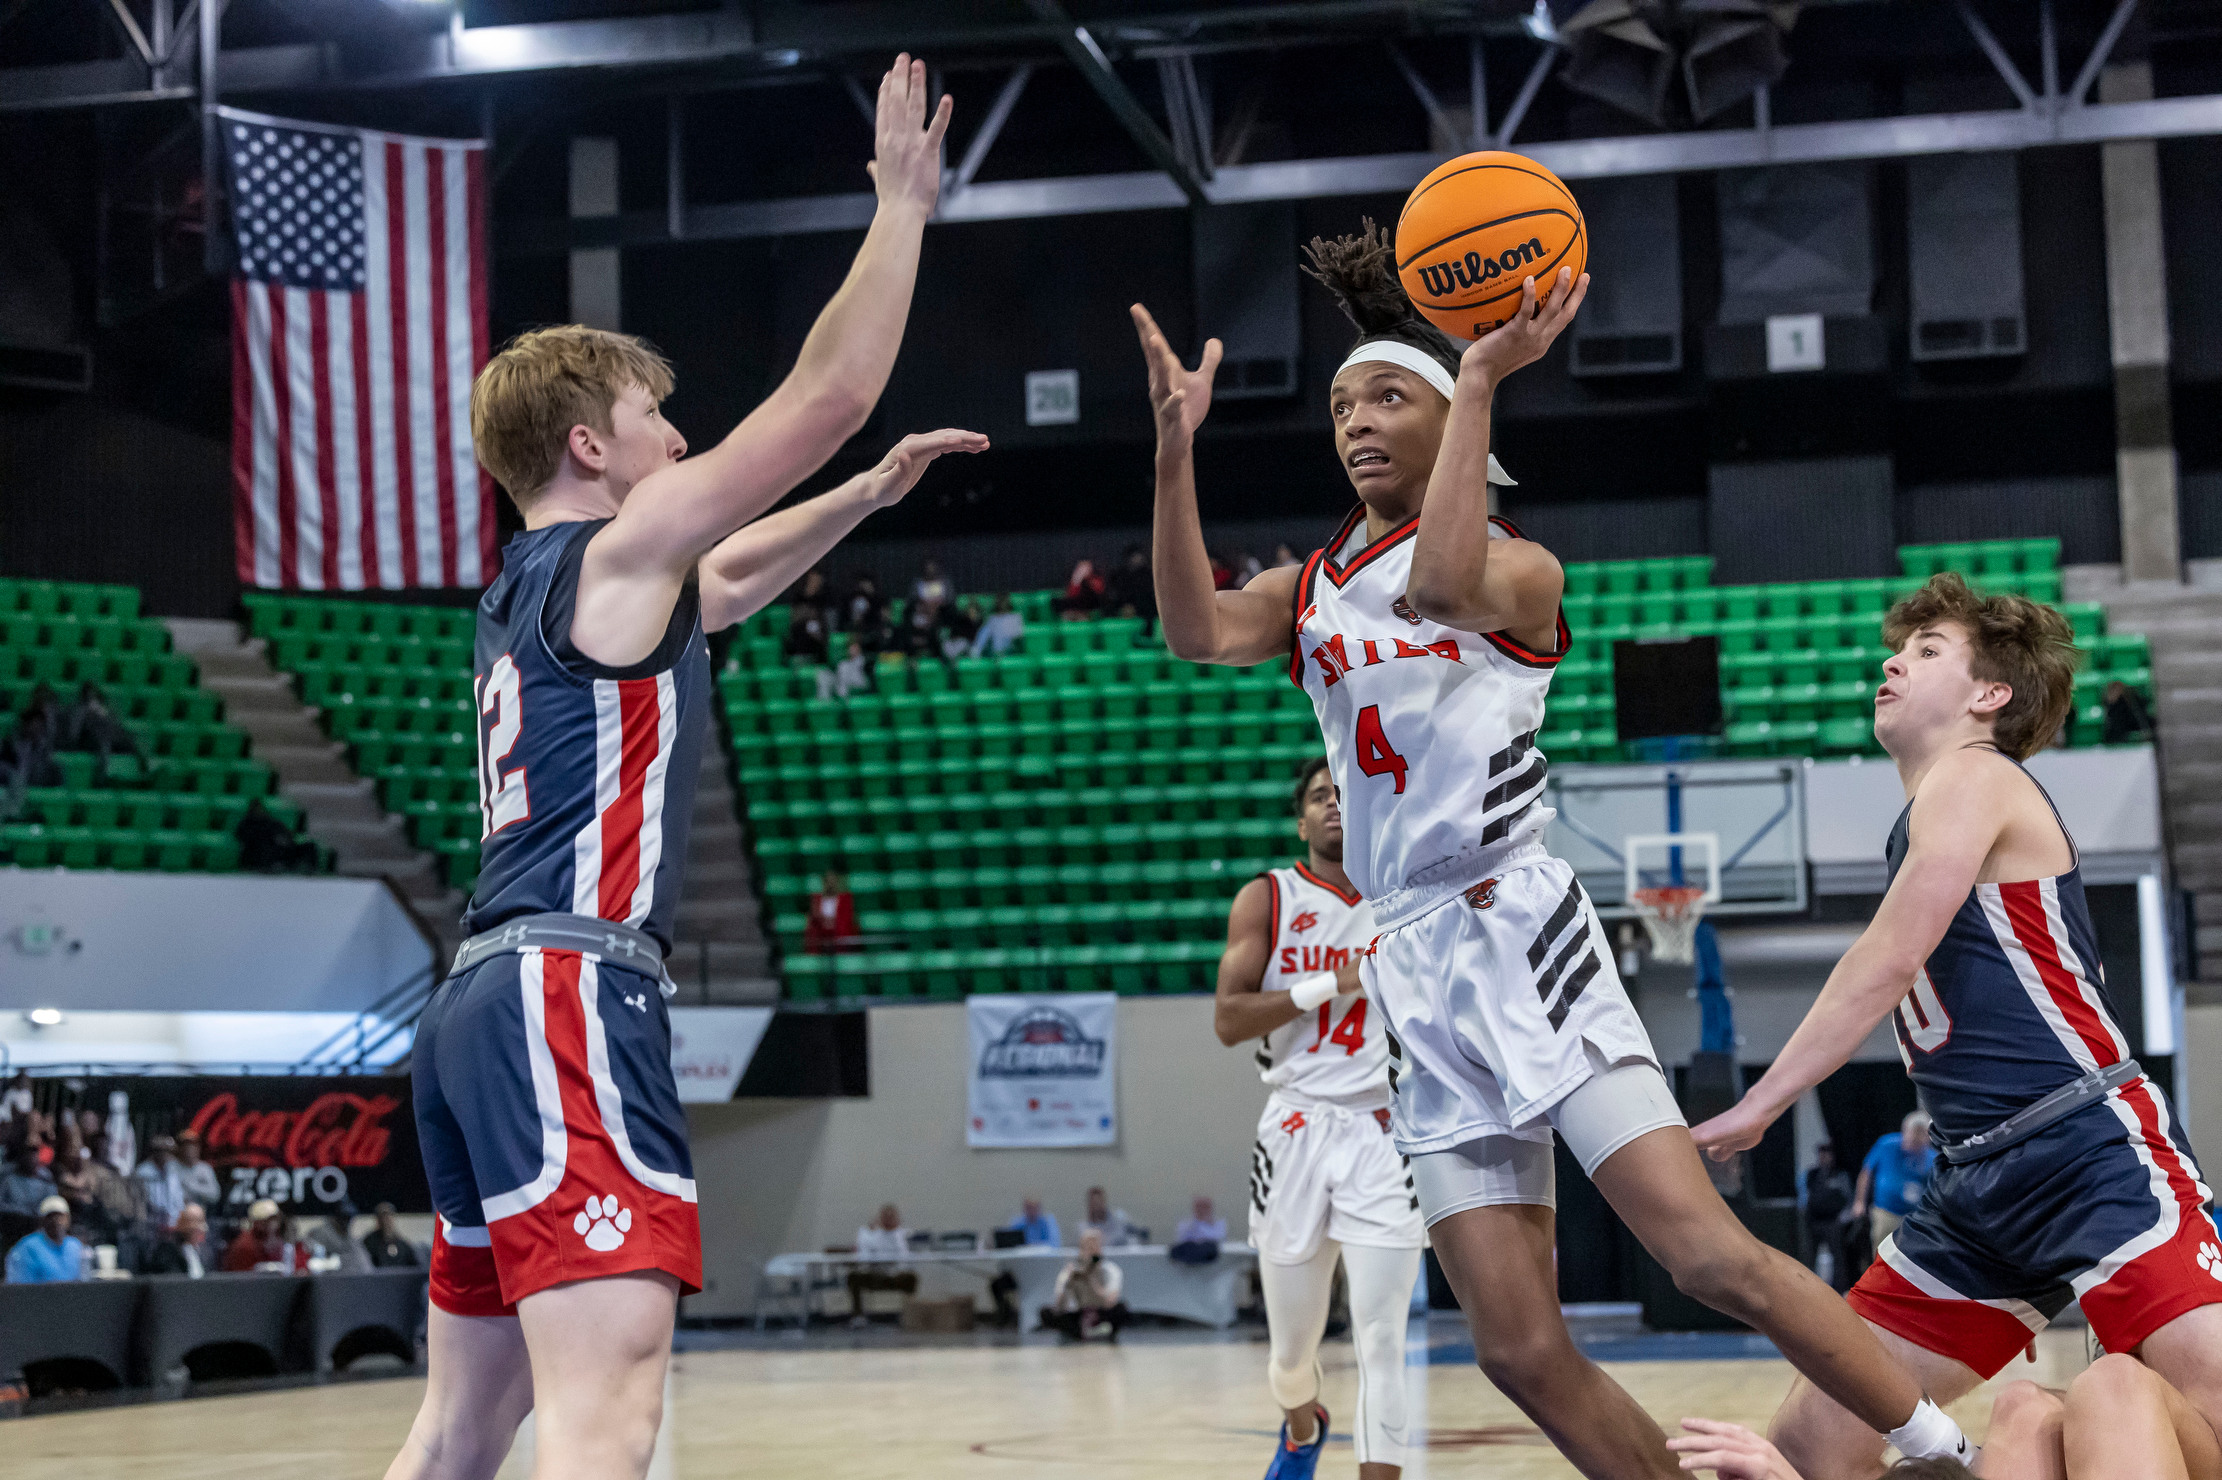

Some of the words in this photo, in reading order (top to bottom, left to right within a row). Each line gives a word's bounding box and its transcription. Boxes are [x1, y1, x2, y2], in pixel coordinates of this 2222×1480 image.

[1417, 237, 1547, 298] Wilson
[1791, 330, 1804, 356] 1
[1356, 704, 1409, 794] 4
[1307, 998, 1369, 1056] 14
[188, 1091, 399, 1169] Coca-Cola
[230, 1164, 348, 1204] zero
